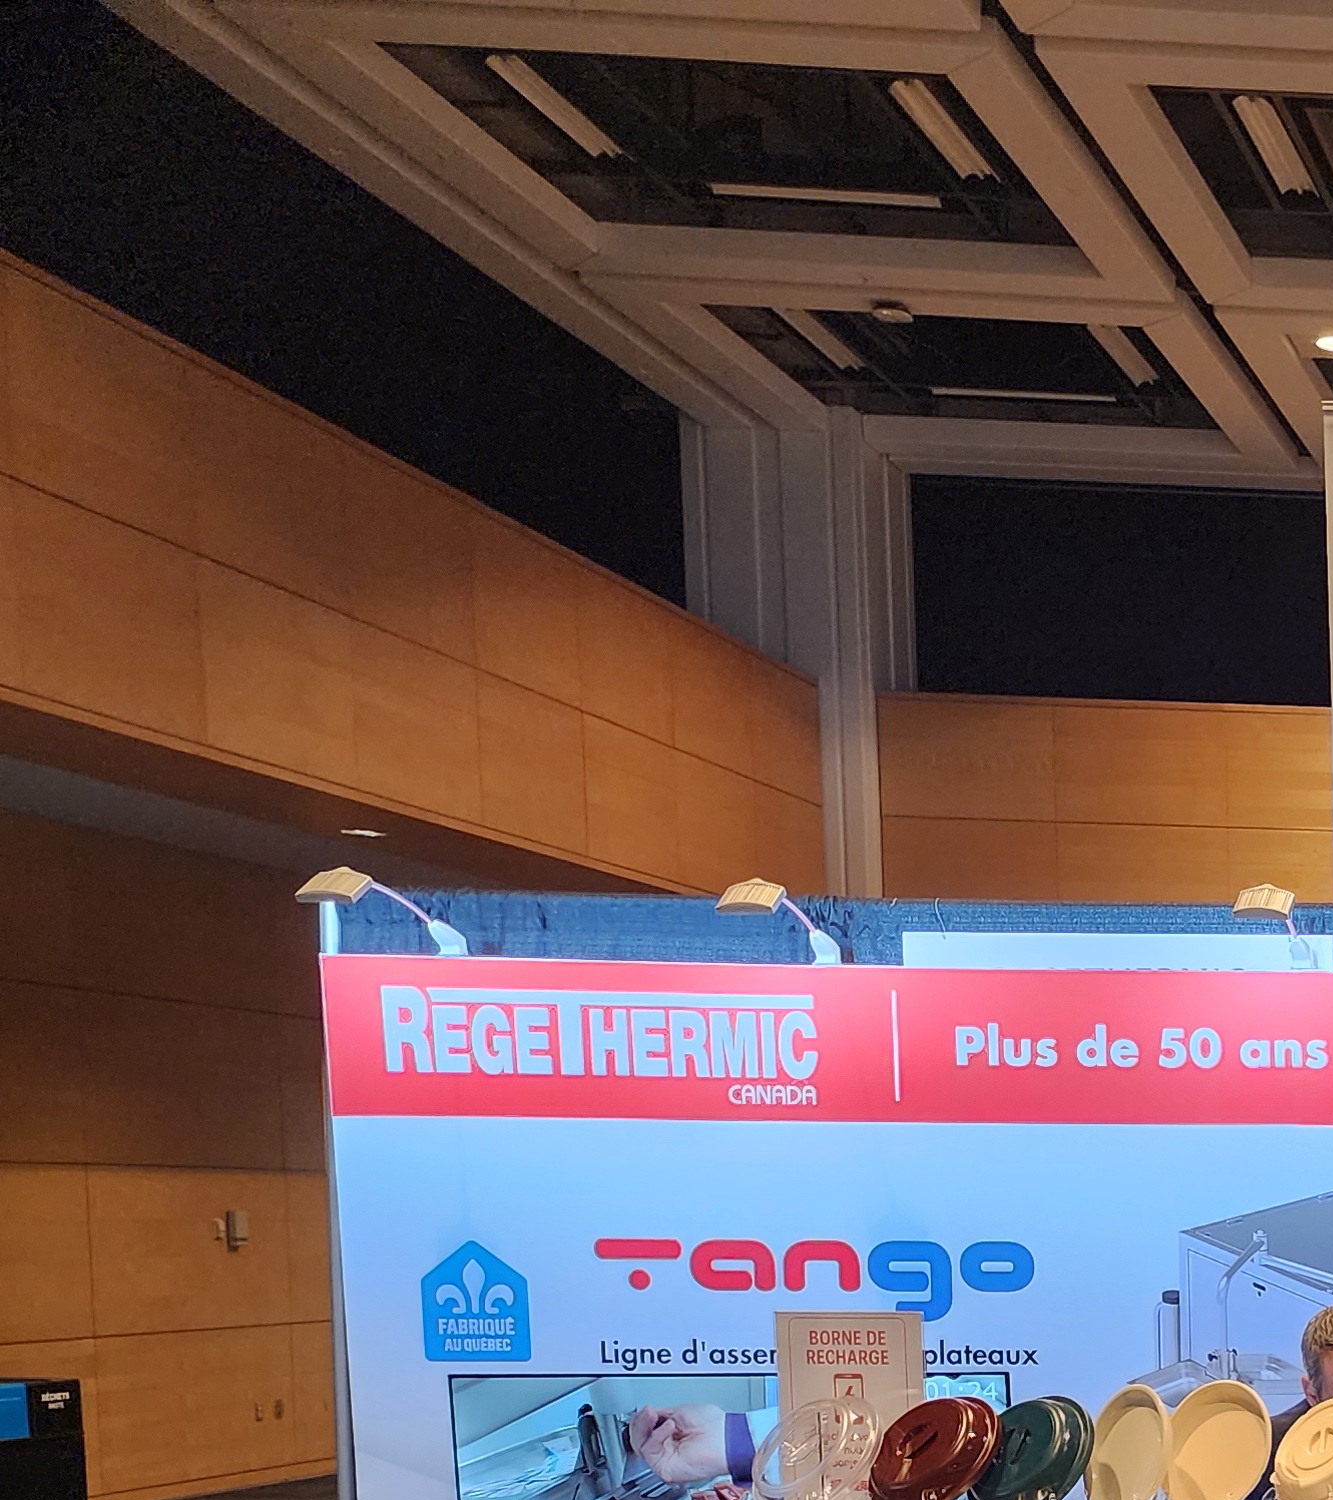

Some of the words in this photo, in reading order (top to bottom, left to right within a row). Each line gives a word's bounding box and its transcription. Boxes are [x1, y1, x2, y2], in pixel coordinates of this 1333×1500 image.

[381, 985, 818, 1079] REGETHERMIC
[955, 1022, 1058, 1067] Plus
[1076, 1023, 1139, 1068] de
[1158, 1027, 1222, 1069] 50
[1239, 1038, 1329, 1069] ans
[728, 1084, 817, 1105] CANADA
[438, 1316, 516, 1336] FABRIQUÉ
[444, 1338, 462, 1352] AU
[463, 1337, 512, 1352] QUÉBEC
[809, 1330, 861, 1346] BORNE
[866, 1330, 886, 1346] DE
[600, 1340, 672, 1371] Ligne
[922, 1339, 1040, 1372] plateaux
[806, 1349, 890, 1365] RECHARGE
